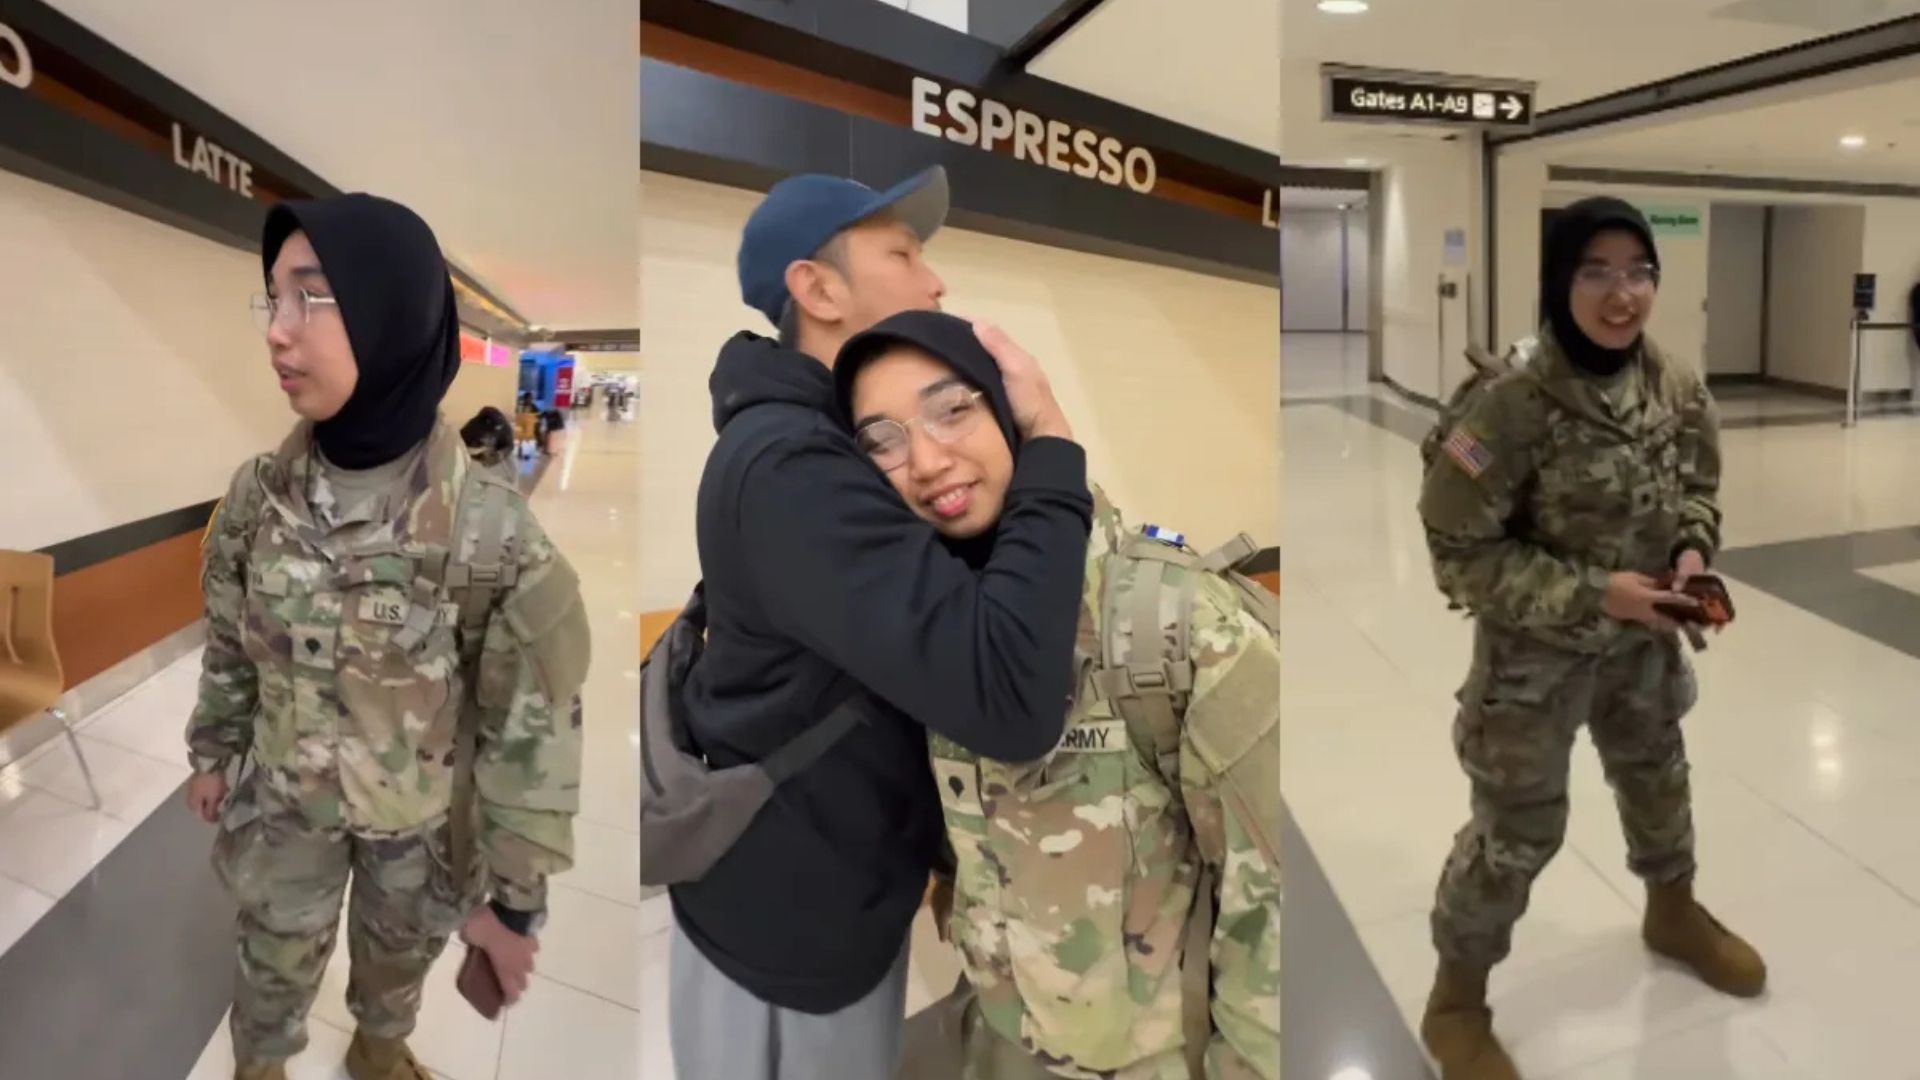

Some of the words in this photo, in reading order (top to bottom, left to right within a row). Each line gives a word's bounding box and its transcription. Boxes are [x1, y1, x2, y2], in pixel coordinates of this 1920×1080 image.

[1350, 87, 1405, 110] Gates
[1410, 92, 1468, 113] A1-A9
[911, 76, 1156, 194] ESPRESSO
[172, 121, 253, 198] LATTE
[1262, 189, 1280, 229] L
[1061, 727, 1109, 748] RMY
